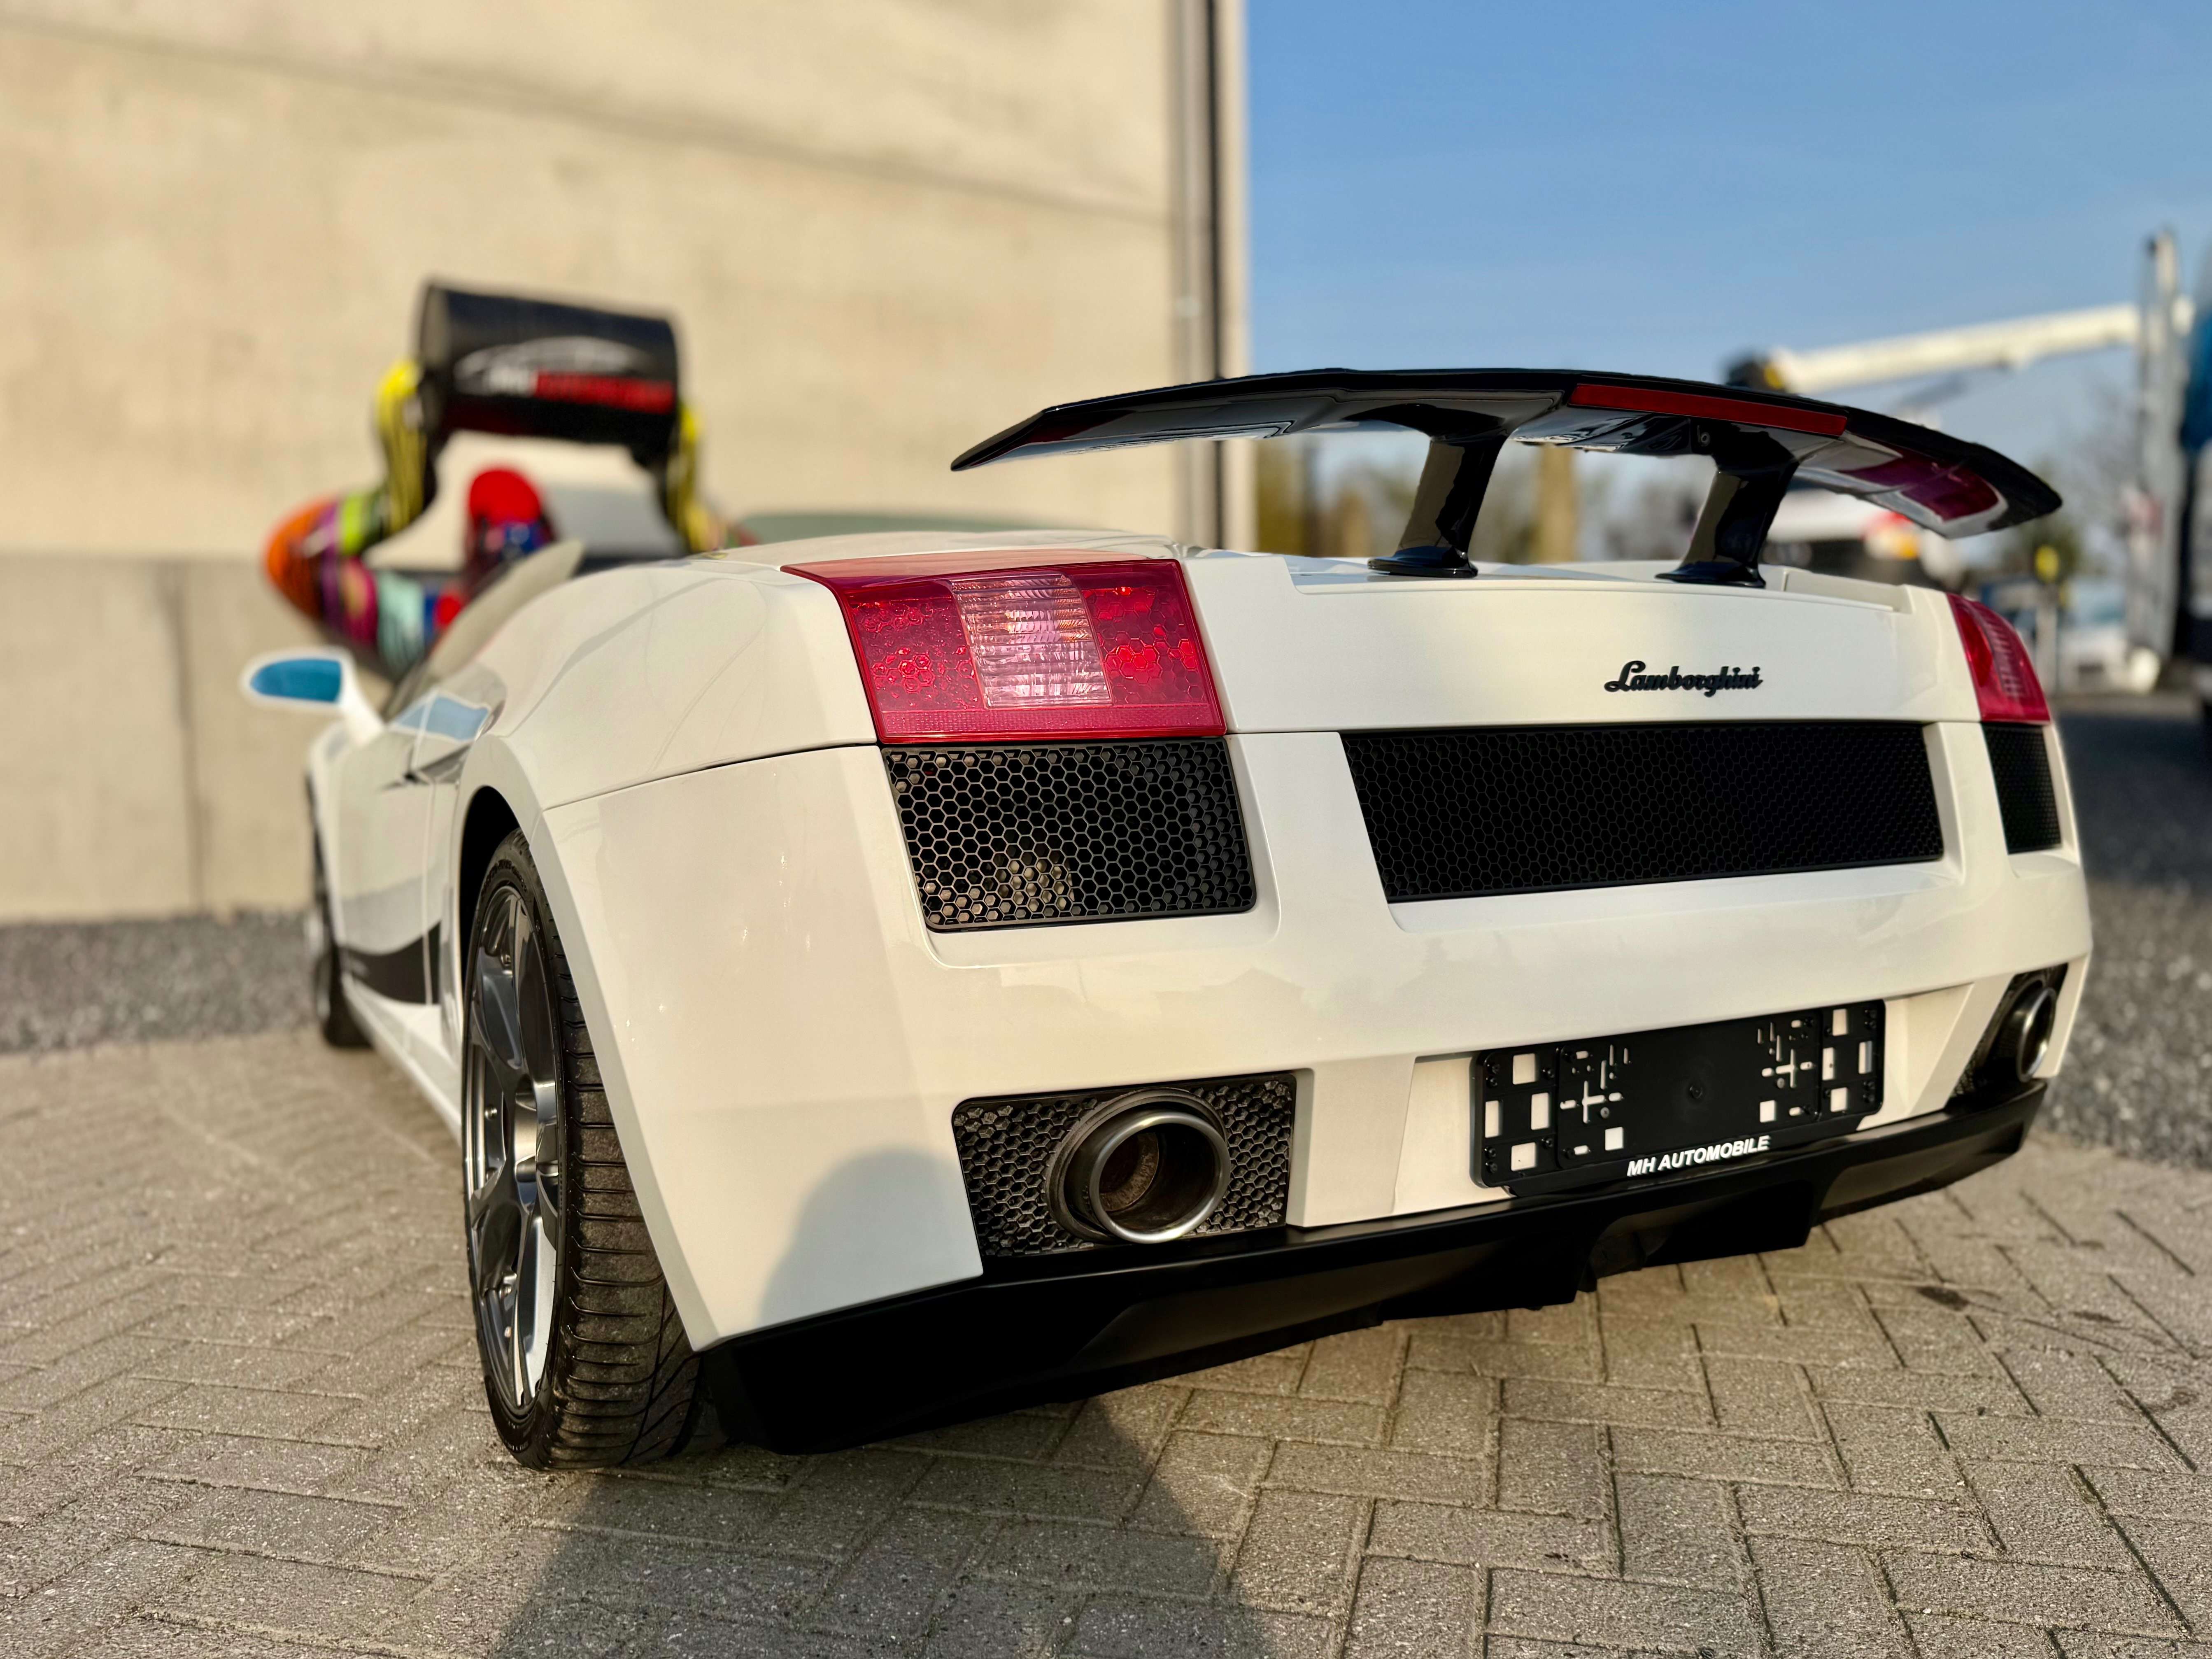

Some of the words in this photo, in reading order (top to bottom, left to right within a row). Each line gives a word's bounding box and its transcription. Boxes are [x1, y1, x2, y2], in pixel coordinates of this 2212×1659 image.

[1604, 660, 1763, 697] Lamborghini
[1627, 1156, 1658, 1177] MH
[1658, 1135, 1771, 1172] AUTOMOBILE
